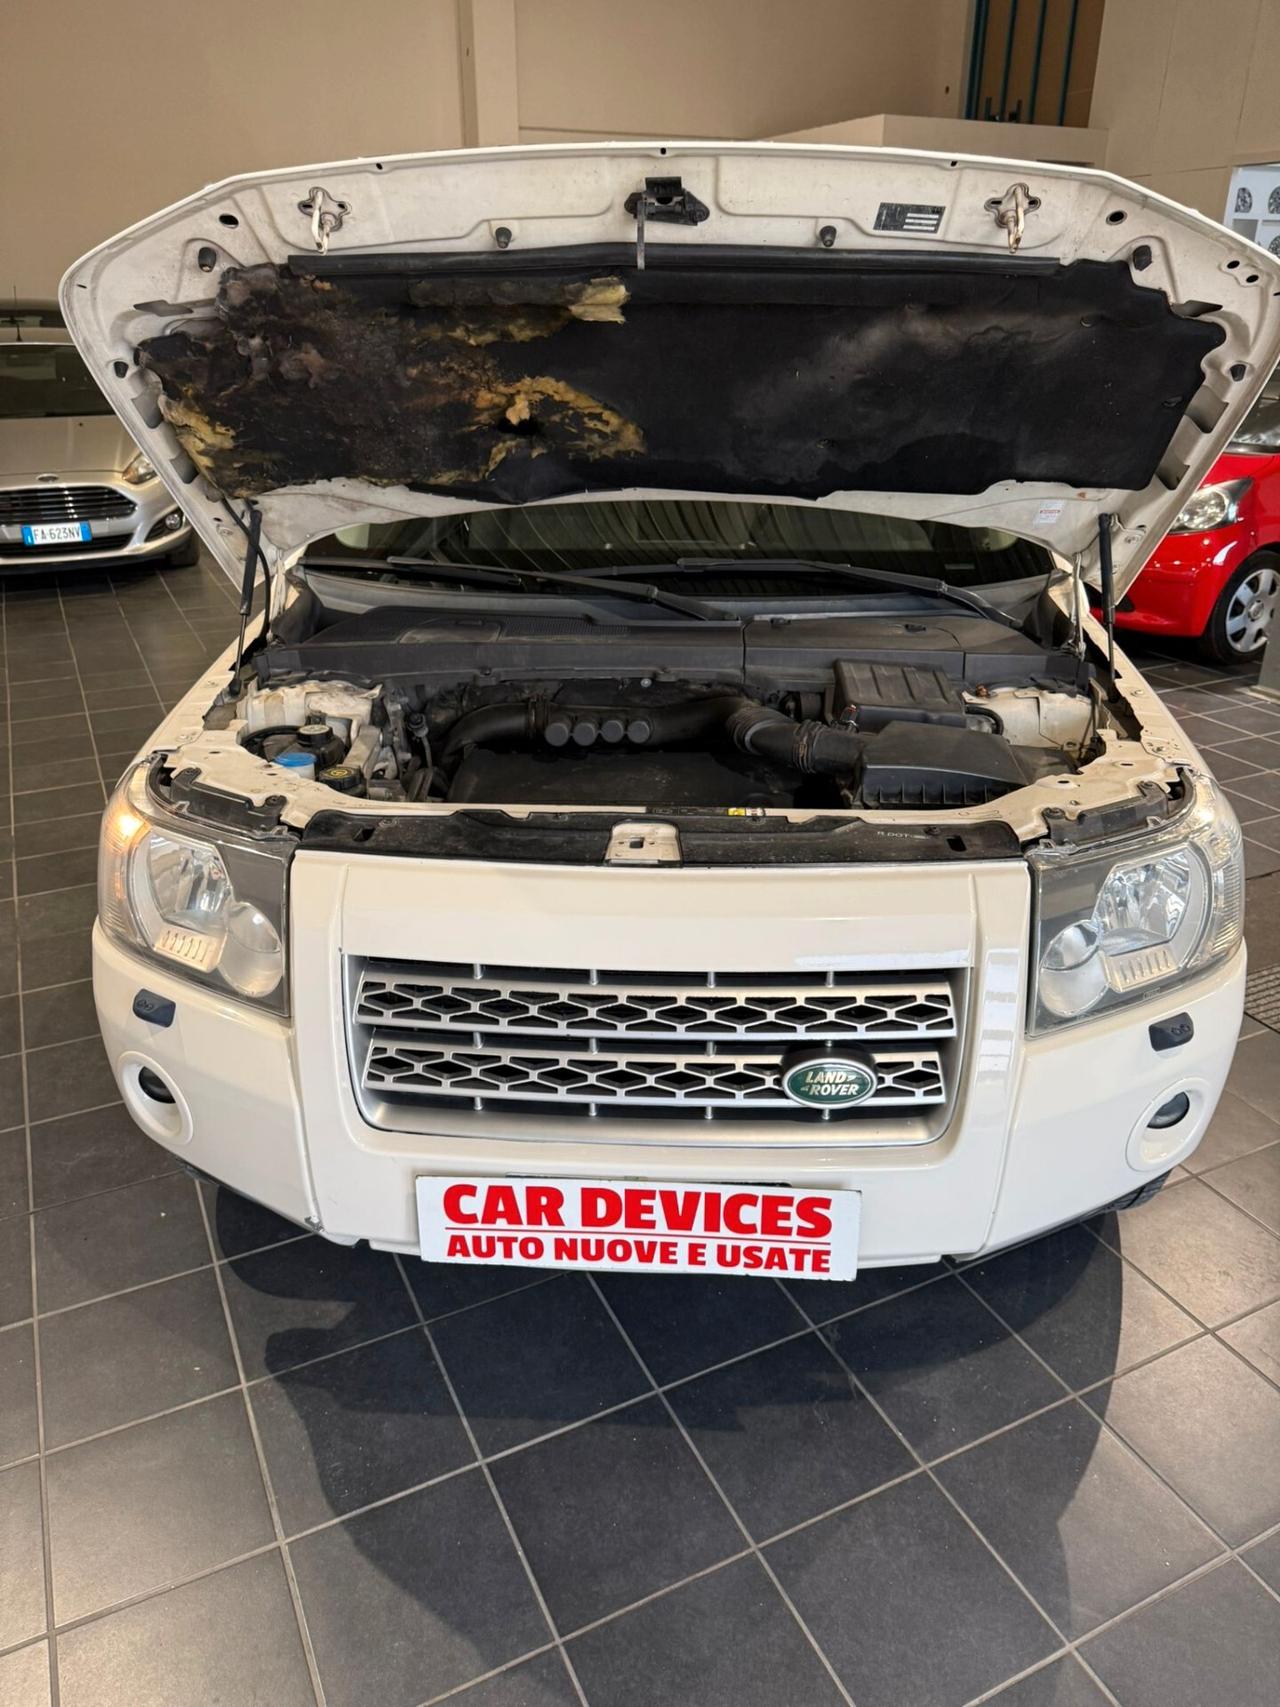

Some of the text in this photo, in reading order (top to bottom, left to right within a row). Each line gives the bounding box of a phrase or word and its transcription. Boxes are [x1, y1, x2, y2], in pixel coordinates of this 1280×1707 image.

[805, 1071, 846, 1084] LAND
[809, 1084, 860, 1096] ROVER
[443, 1184, 833, 1240] CAR DEVICES
[447, 1235, 830, 1274] AUTO NUOVE E USATE
